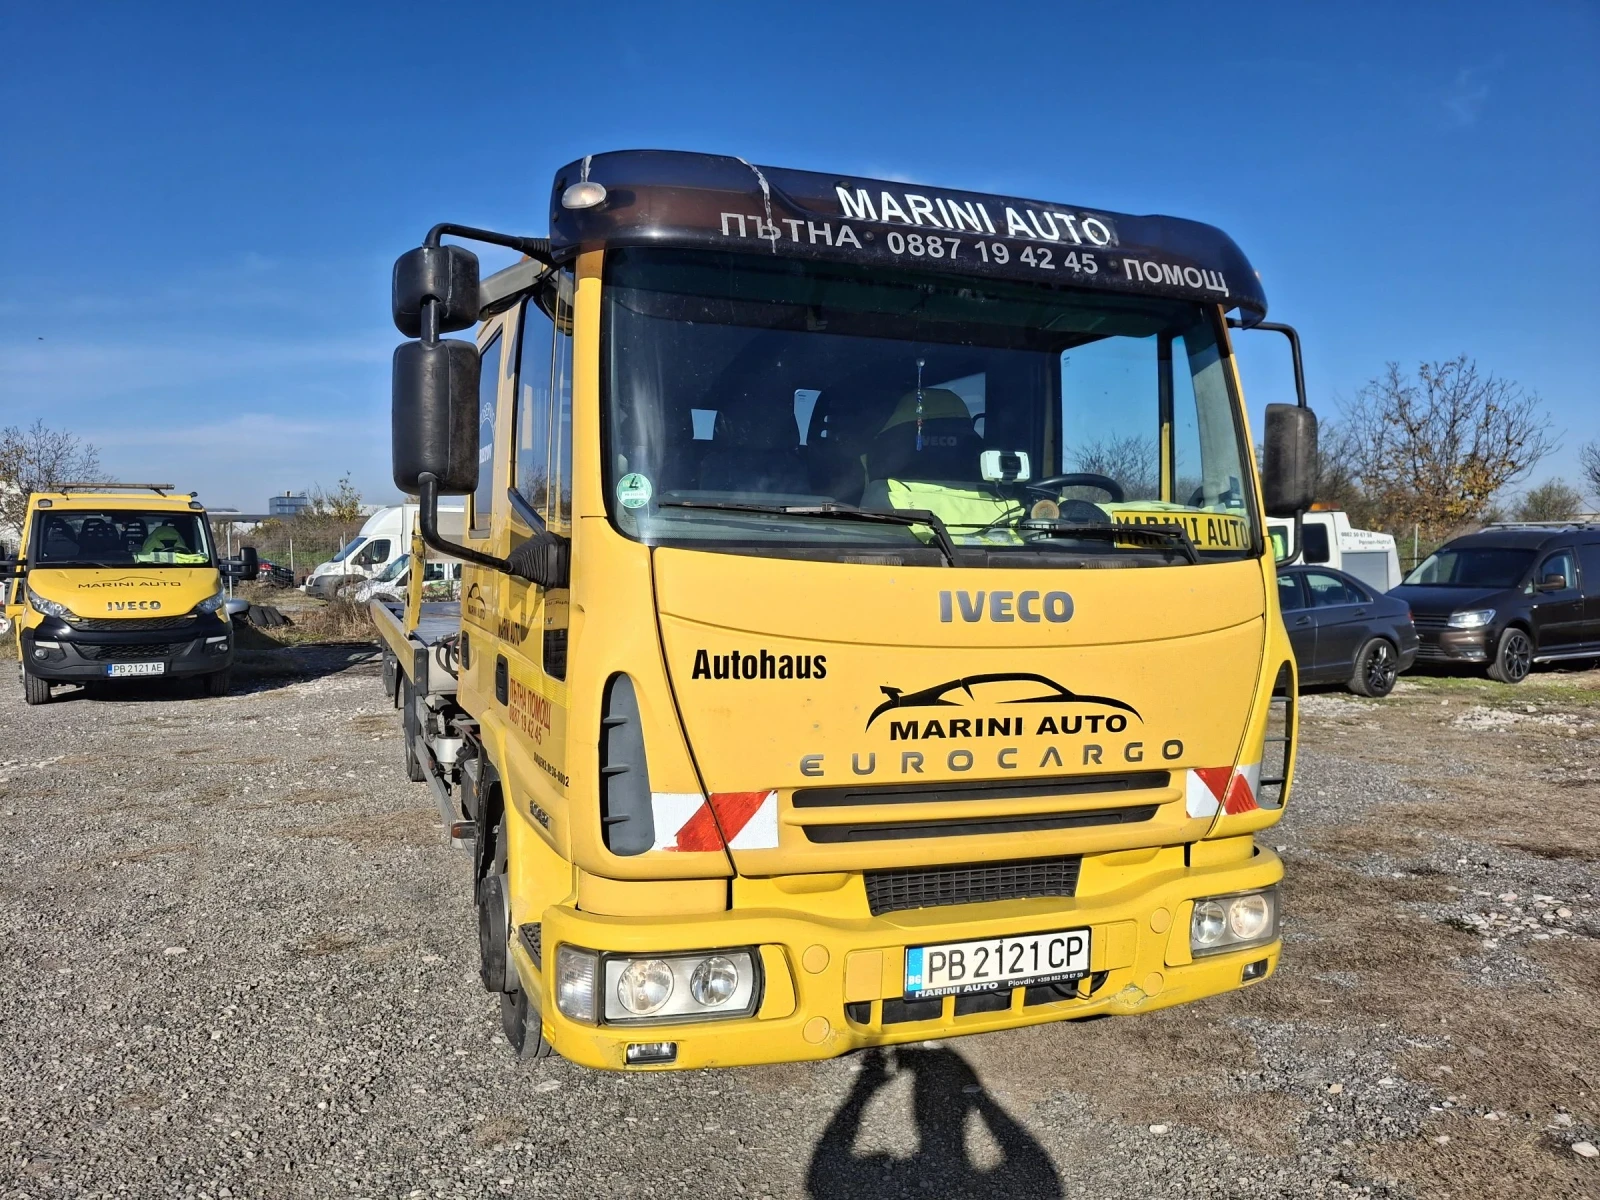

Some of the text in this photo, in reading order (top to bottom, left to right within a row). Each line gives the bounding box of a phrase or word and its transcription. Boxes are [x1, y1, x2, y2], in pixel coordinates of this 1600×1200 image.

[835, 186, 1111, 246] MARINI AUTO
[720, 211, 1230, 298] ПЪТНА 0887 19 42 45 ПОМОЩ
[1207, 518, 1250, 549] AUTO
[107, 600, 162, 611] IVECO
[938, 590, 1075, 623] IVECO
[113, 663, 163, 673] PB 2121 AE
[691, 649, 828, 680] Autohaus
[510, 678, 552, 736] ПЪТНА ПОМОЩ
[890, 714, 1128, 741] MARINI AUTO
[799, 739, 1184, 777] EUROCARGO
[928, 936, 1083, 984] PB 2121 CP
[908, 975, 921, 986] BG
[915, 985, 960, 998] MARINI
[964, 981, 999, 993] AUTO
[1008, 977, 1035, 987] Plovdiv
